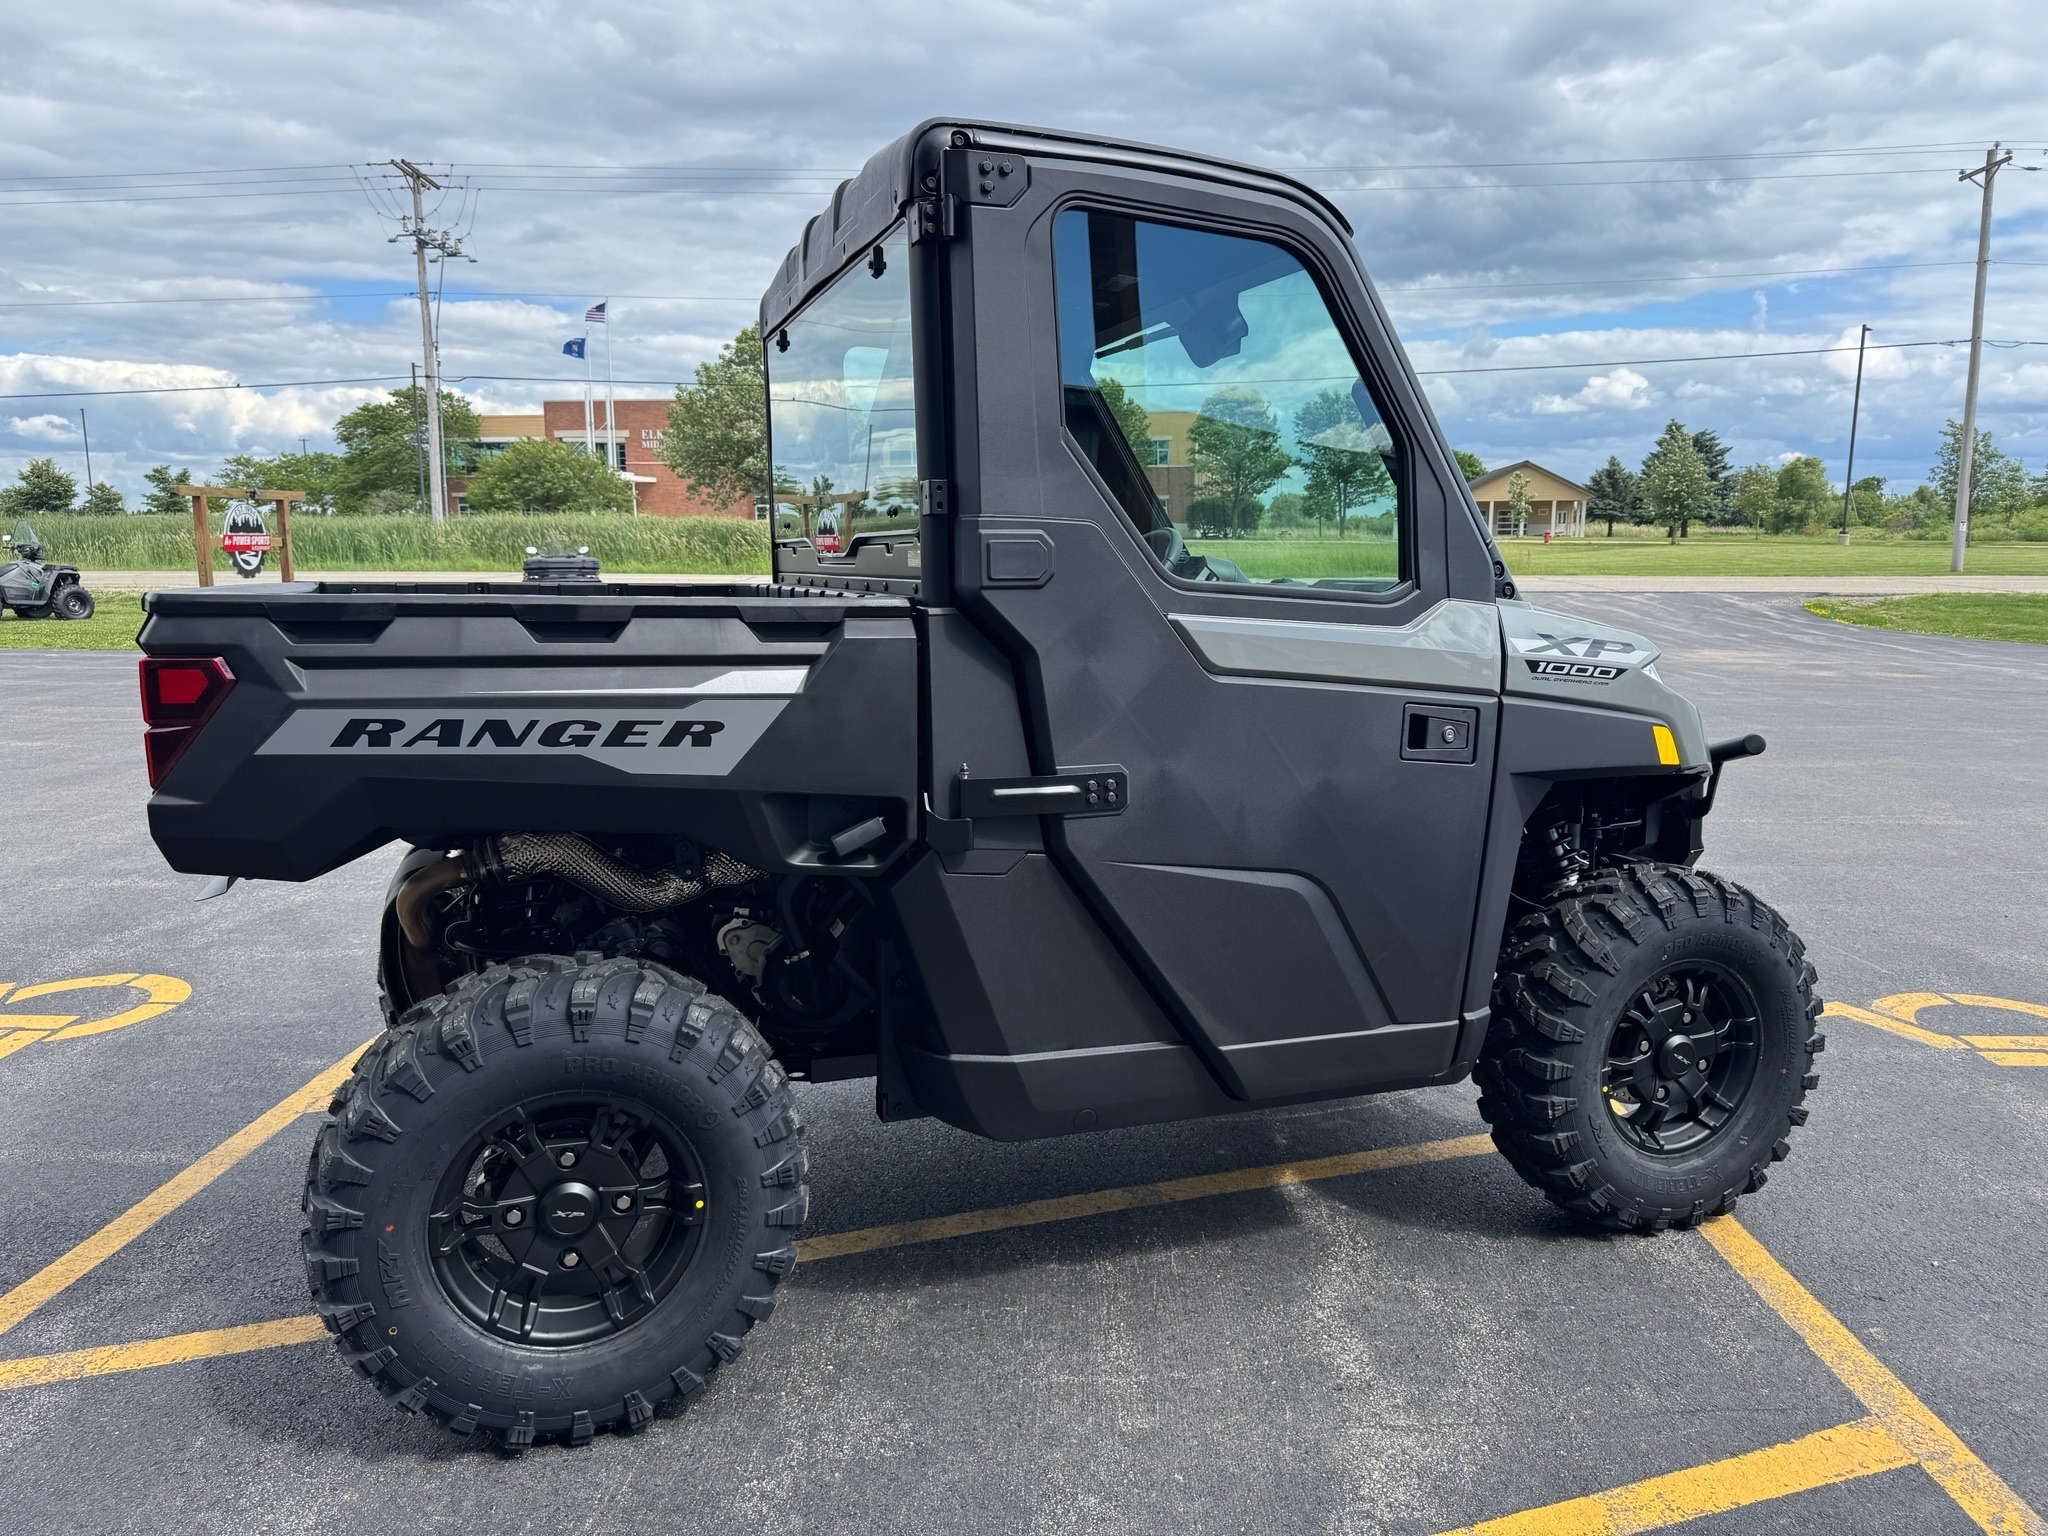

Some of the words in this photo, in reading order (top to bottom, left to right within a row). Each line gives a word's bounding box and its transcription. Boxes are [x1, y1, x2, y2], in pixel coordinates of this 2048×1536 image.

[224, 535, 232, 546] A+
[232, 535, 251, 546] POWER
[251, 535, 270, 546] SPORTS
[1523, 633, 1637, 658] XP
[1536, 661, 1618, 680] 1000
[1553, 677, 1593, 685] OVERHEAD
[329, 718, 725, 748] RANGER
[564, 1056, 619, 1074] PRO
[551, 1210, 586, 1218] XP
[413, 1330, 574, 1400] X-TERRAIN
